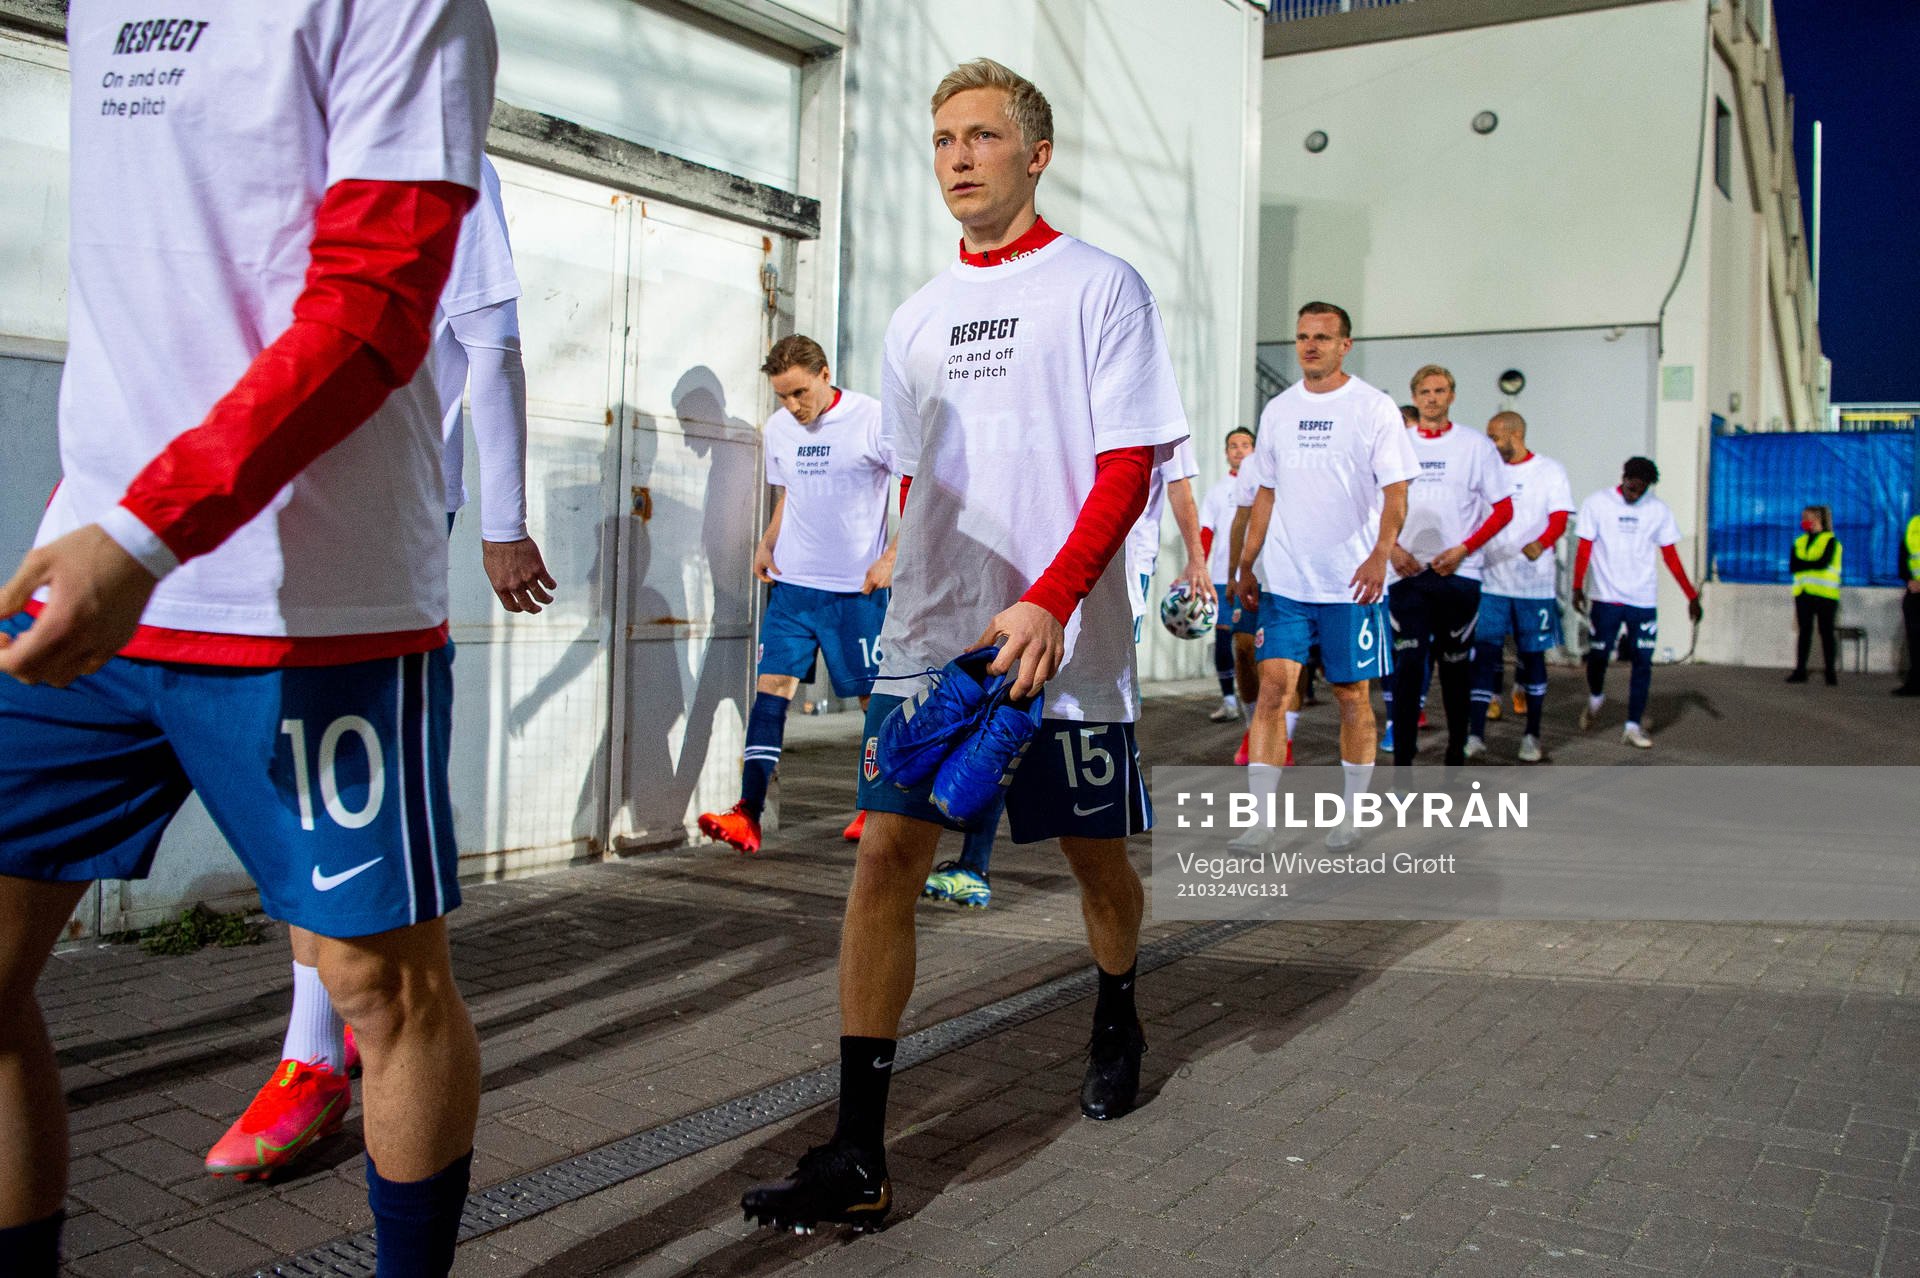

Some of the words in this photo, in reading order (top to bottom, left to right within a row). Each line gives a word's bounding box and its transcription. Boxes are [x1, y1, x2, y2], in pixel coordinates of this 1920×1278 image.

[112, 19, 209, 55] RESPECT
[102, 71, 124, 88] On
[128, 67, 156, 87] and
[158, 67, 186, 86] off
[101, 98, 127, 116] the
[950, 317, 1020, 347] RESPECT
[966, 350, 991, 362] and
[995, 347, 1014, 360] off
[948, 368, 969, 380] the
[974, 365, 1007, 381] pitch
[1298, 420, 1334, 431] RESPECT
[797, 446, 831, 457] RESPECT
[1538, 608, 1549, 630] 2
[1358, 618, 1374, 650] 6
[858, 634, 885, 668] 16
[1055, 725, 1115, 788] 15
[281, 714, 385, 831] 10
